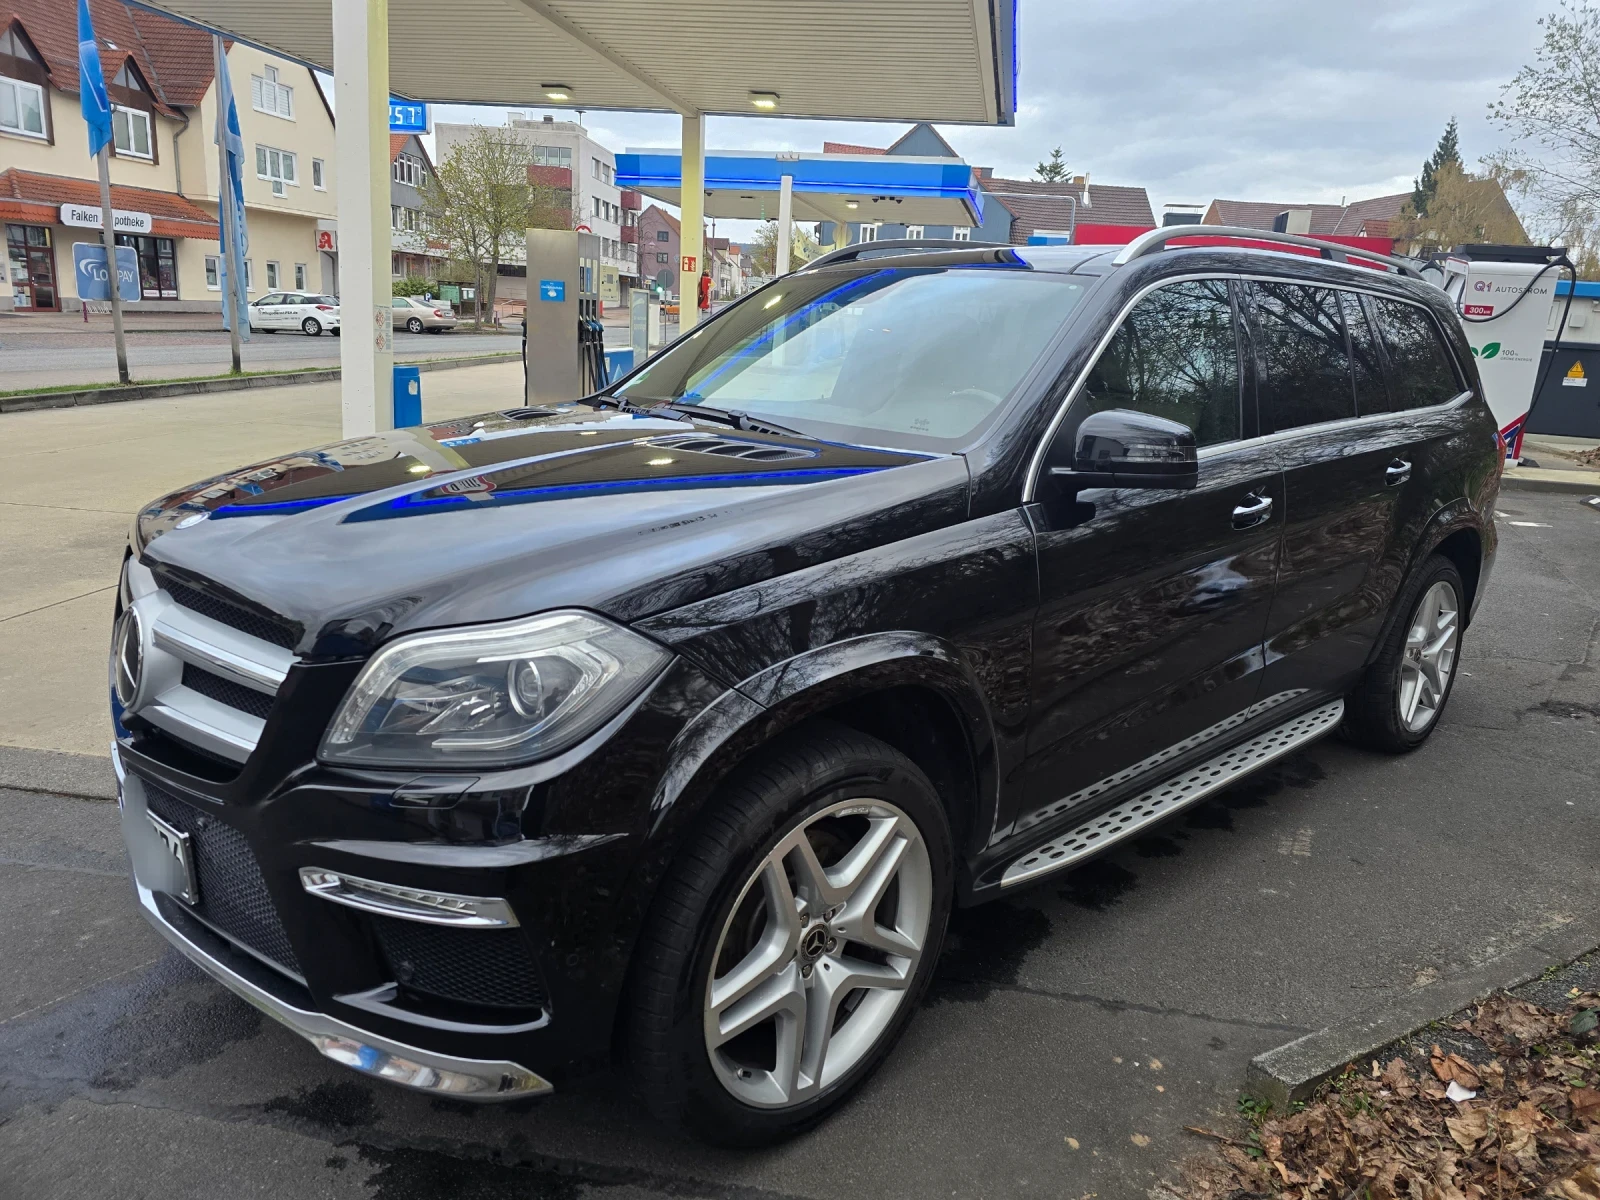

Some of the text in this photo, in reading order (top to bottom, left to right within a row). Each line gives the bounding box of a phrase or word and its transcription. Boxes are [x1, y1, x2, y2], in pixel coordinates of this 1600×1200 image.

[71, 209, 144, 228] Falken potheke
[93, 268, 134, 283] LOPAY
[1474, 280, 1492, 292] Q1
[1469, 306, 1484, 314] 300
